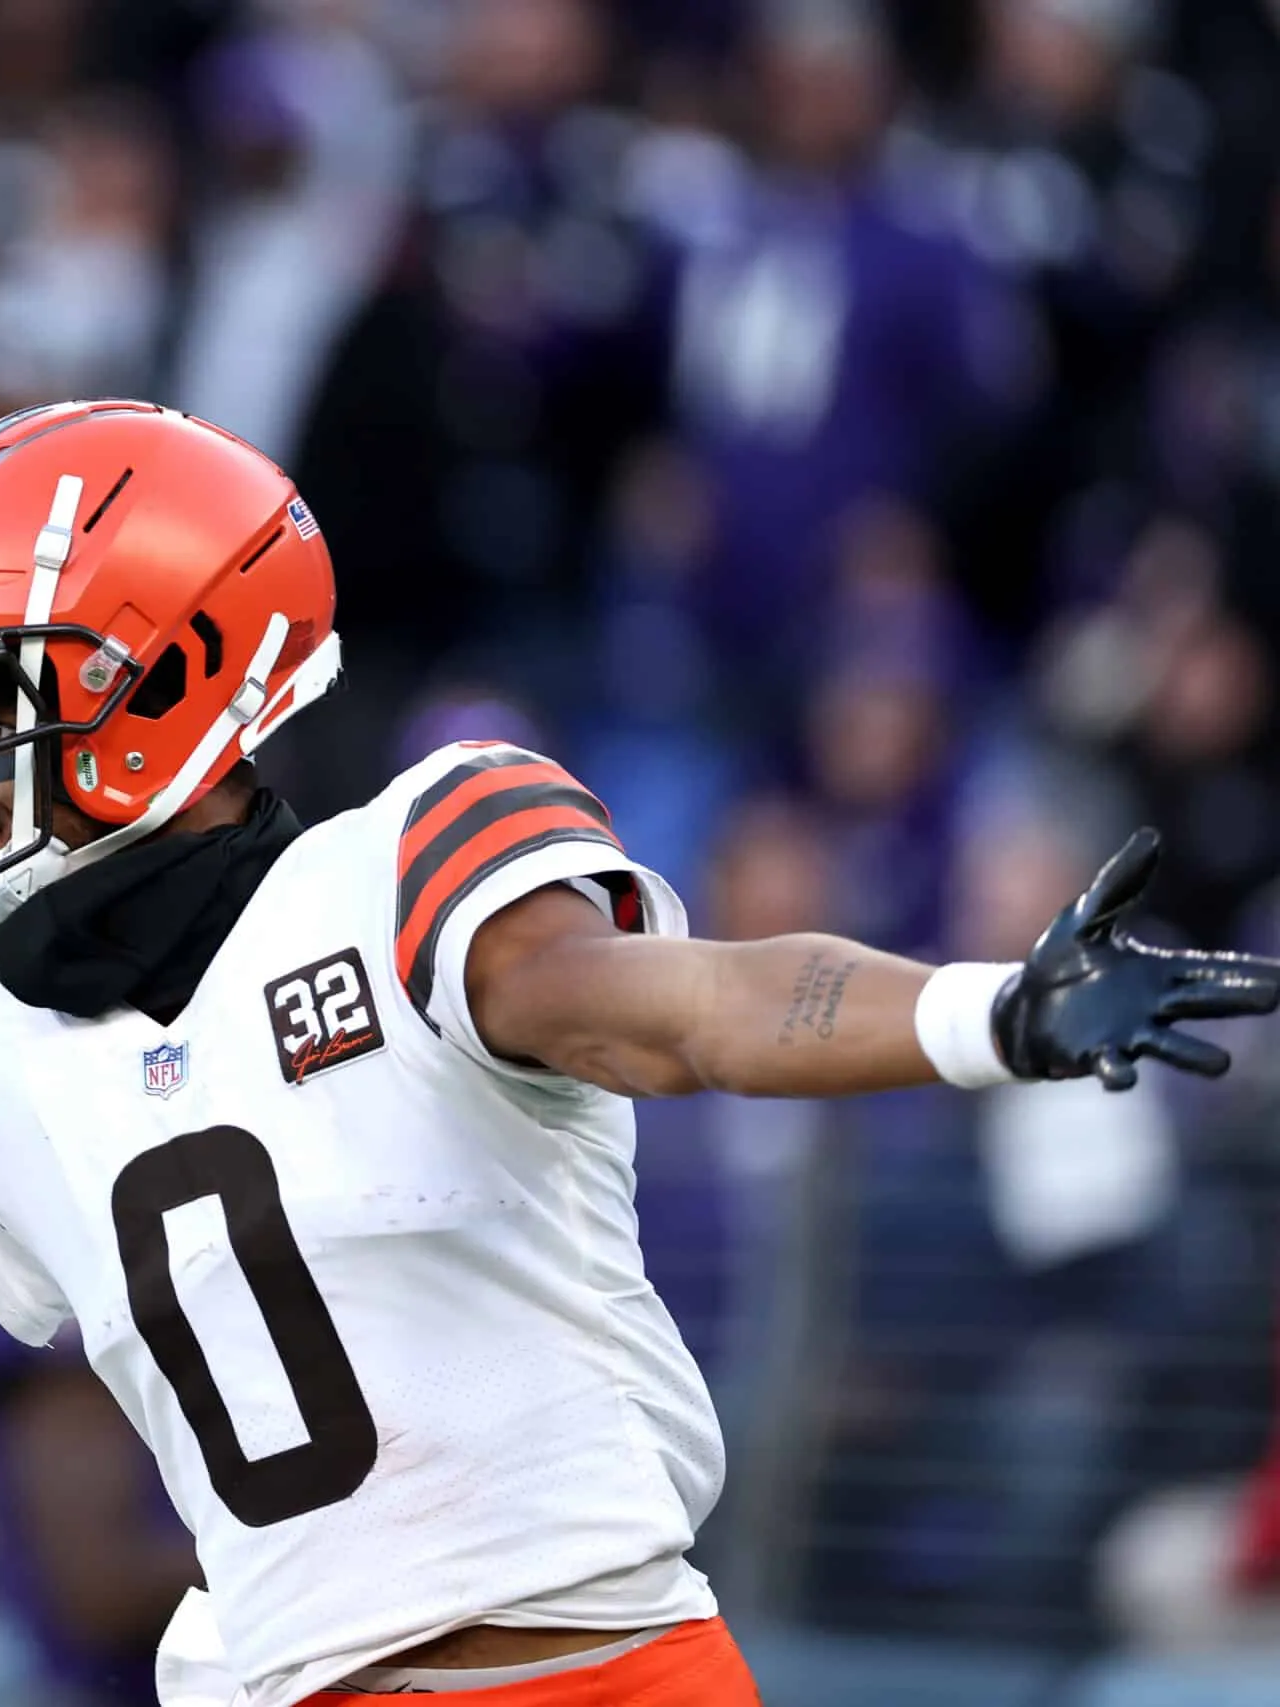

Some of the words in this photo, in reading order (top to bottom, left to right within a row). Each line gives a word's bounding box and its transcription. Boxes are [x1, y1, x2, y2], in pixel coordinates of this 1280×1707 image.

[274, 961, 370, 1054] 32
[148, 1062, 180, 1087] NFL
[112, 1124, 378, 1528] 0
